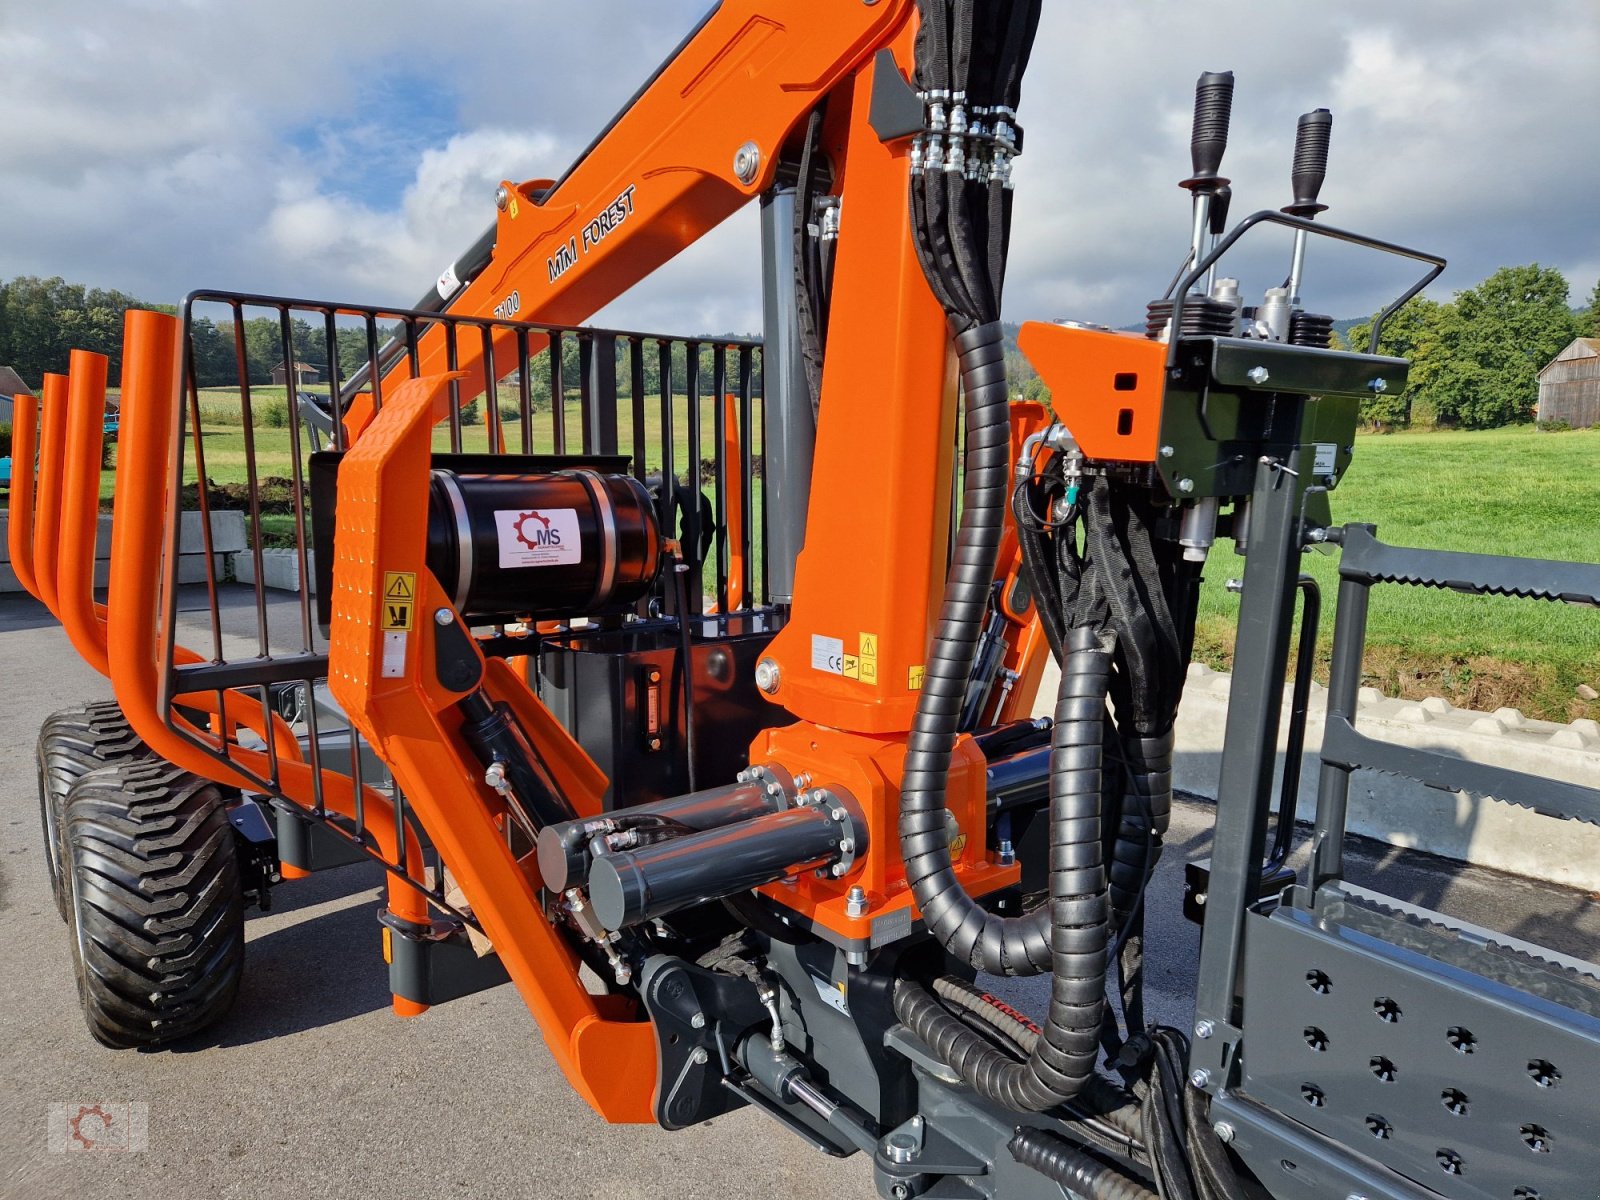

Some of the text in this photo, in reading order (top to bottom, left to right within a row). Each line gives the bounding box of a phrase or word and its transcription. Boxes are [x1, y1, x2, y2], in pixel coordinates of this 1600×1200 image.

[547, 184, 636, 283] MTM FOREST
[494, 290, 520, 320] 7100
